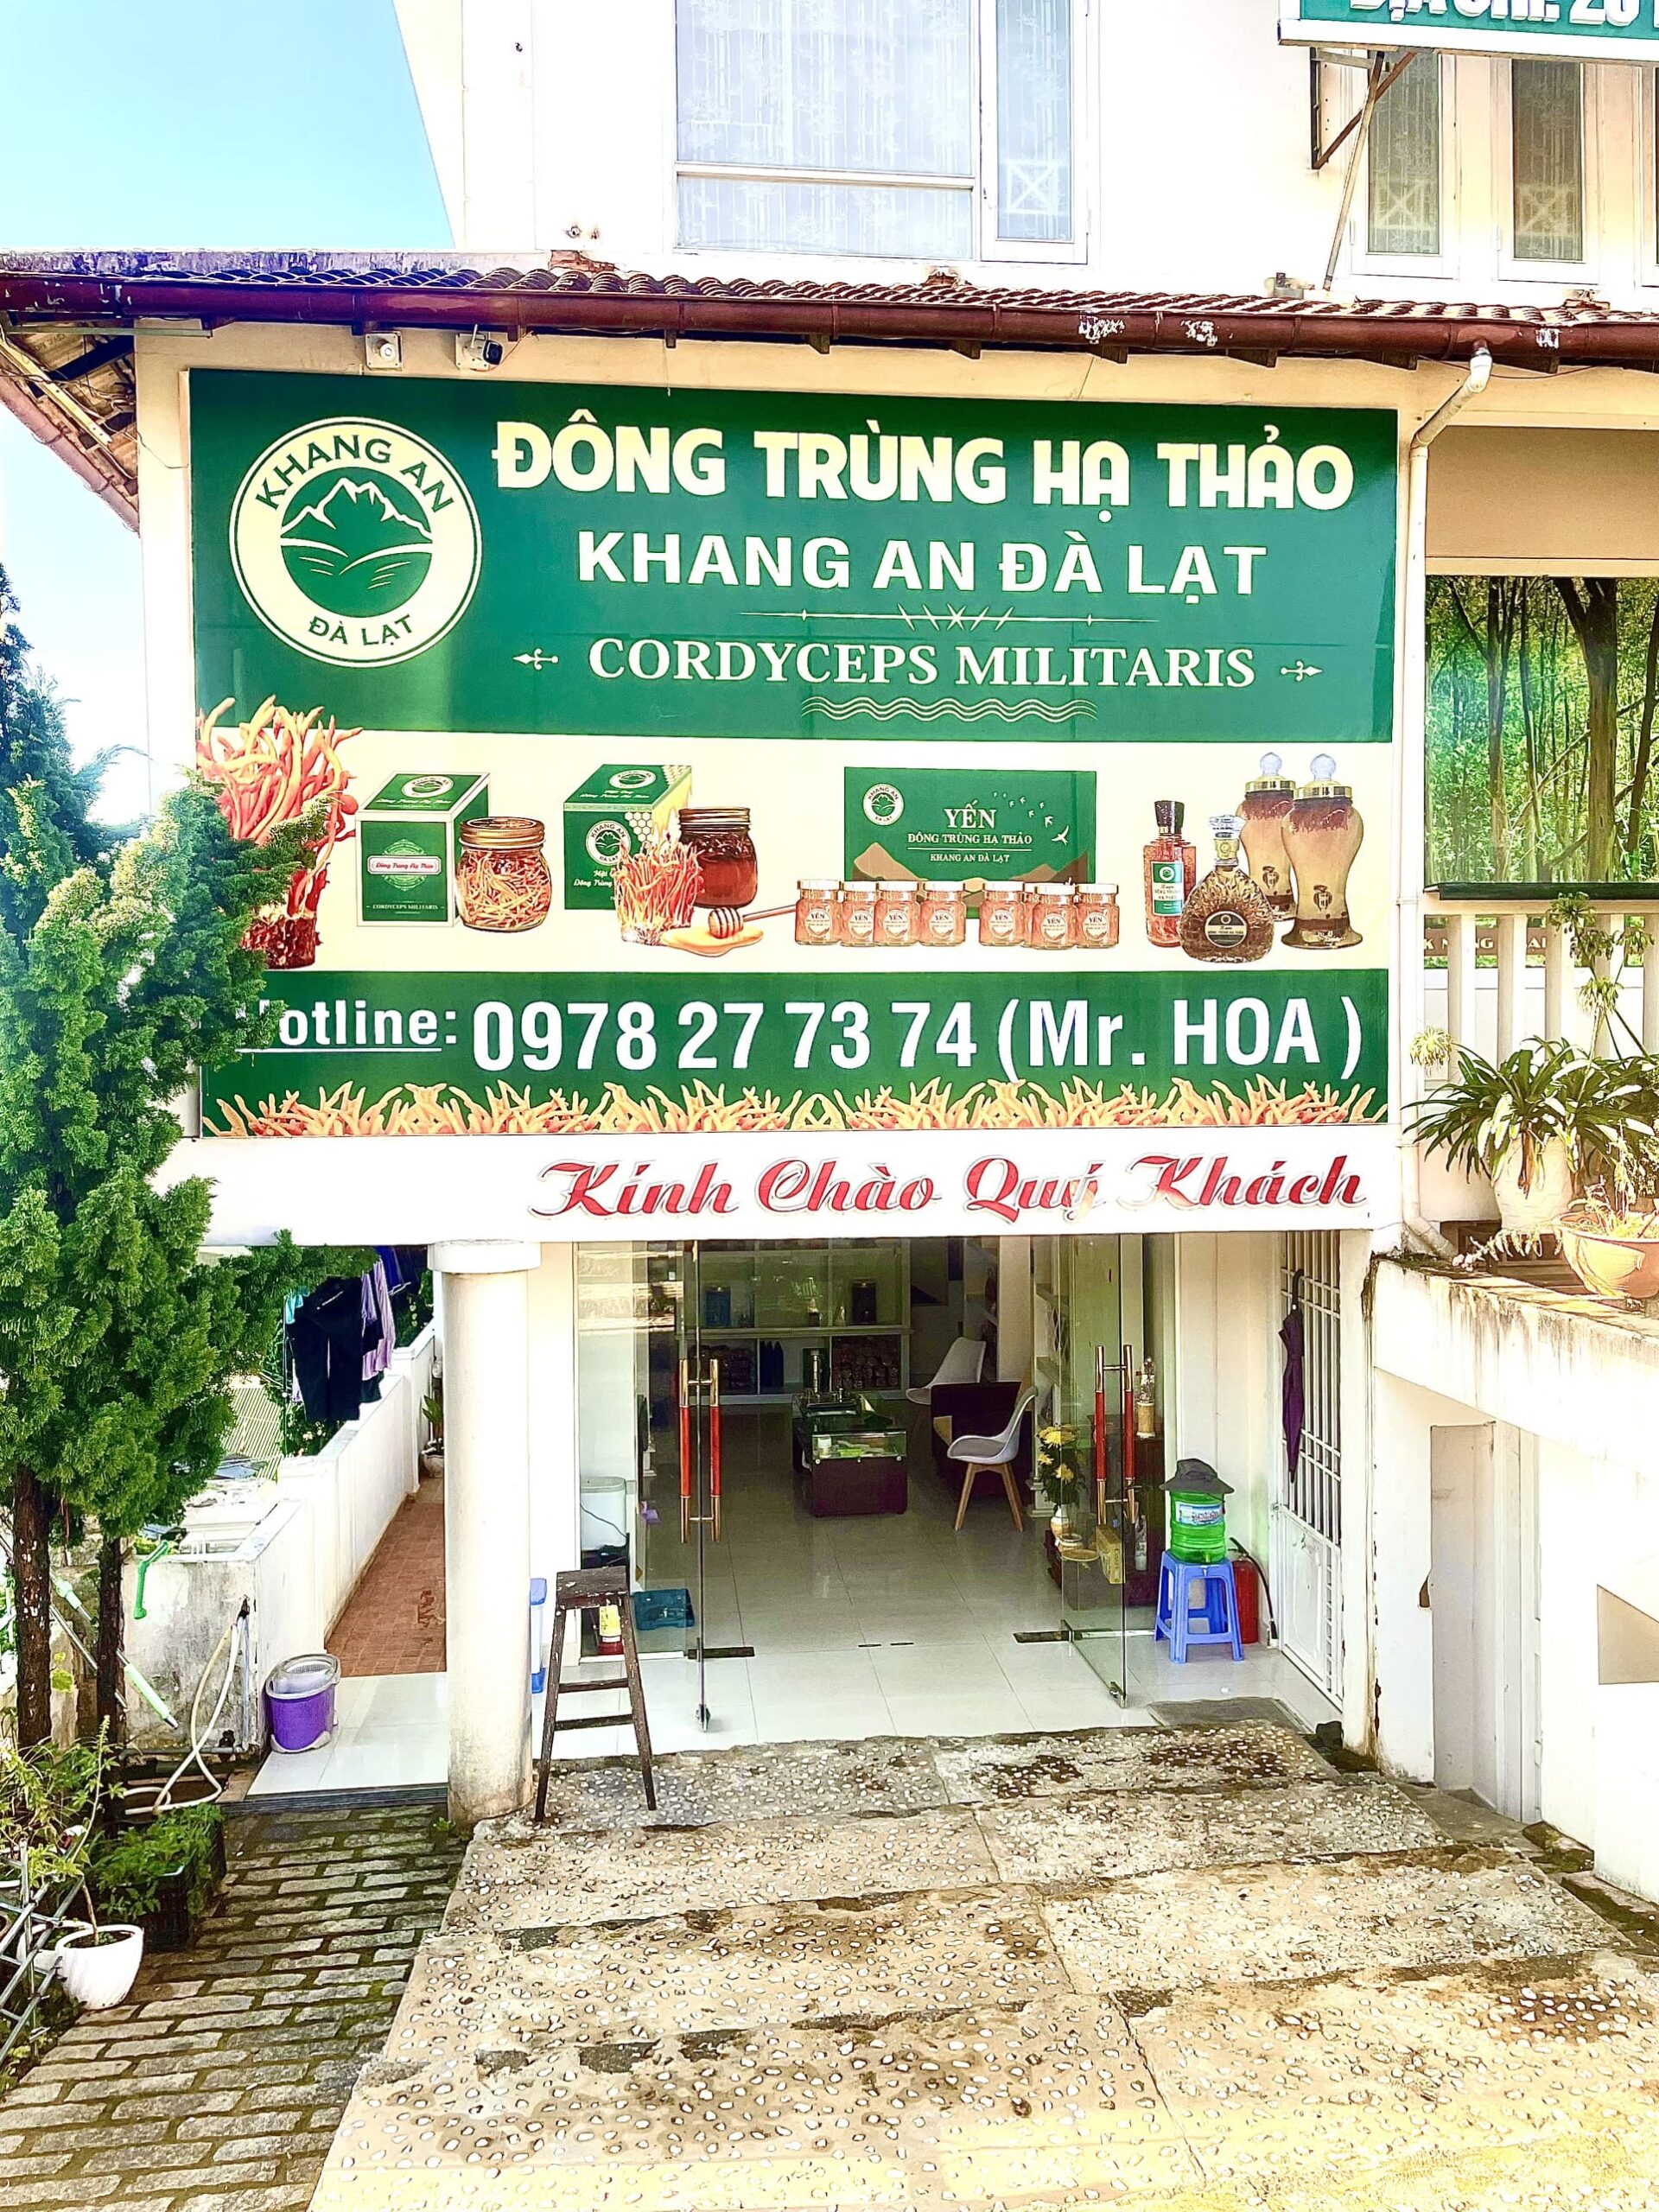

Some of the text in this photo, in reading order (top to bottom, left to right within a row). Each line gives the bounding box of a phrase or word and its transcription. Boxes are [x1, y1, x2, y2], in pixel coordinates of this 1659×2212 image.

[255, 435, 454, 514] KHANG AN
[492, 409, 1354, 523] ĐÔNG TRÙNG HẠ THẢO
[579, 530, 1267, 604] KHANG AN ĐÀ LẠT
[308, 614, 413, 647] ĐÀ LẠT
[588, 638, 1255, 689] CORDYCEPS MILITARIS
[591, 823, 615, 838] KHANG
[907, 831, 1033, 846] ĐÔNG TRÙNG HẠ THẢO
[944, 799, 996, 829] YẾN
[234, 998, 456, 1046] otline:
[474, 1001, 656, 1071] 0978
[678, 1002, 763, 1069] 27
[785, 1001, 870, 1069] 73
[892, 1001, 976, 1068] 74
[997, 999, 1146, 1082] (Mr.
[1173, 996, 1320, 1067] HOA
[531, 1153, 1370, 1224] Kính Chào Quý Khách
